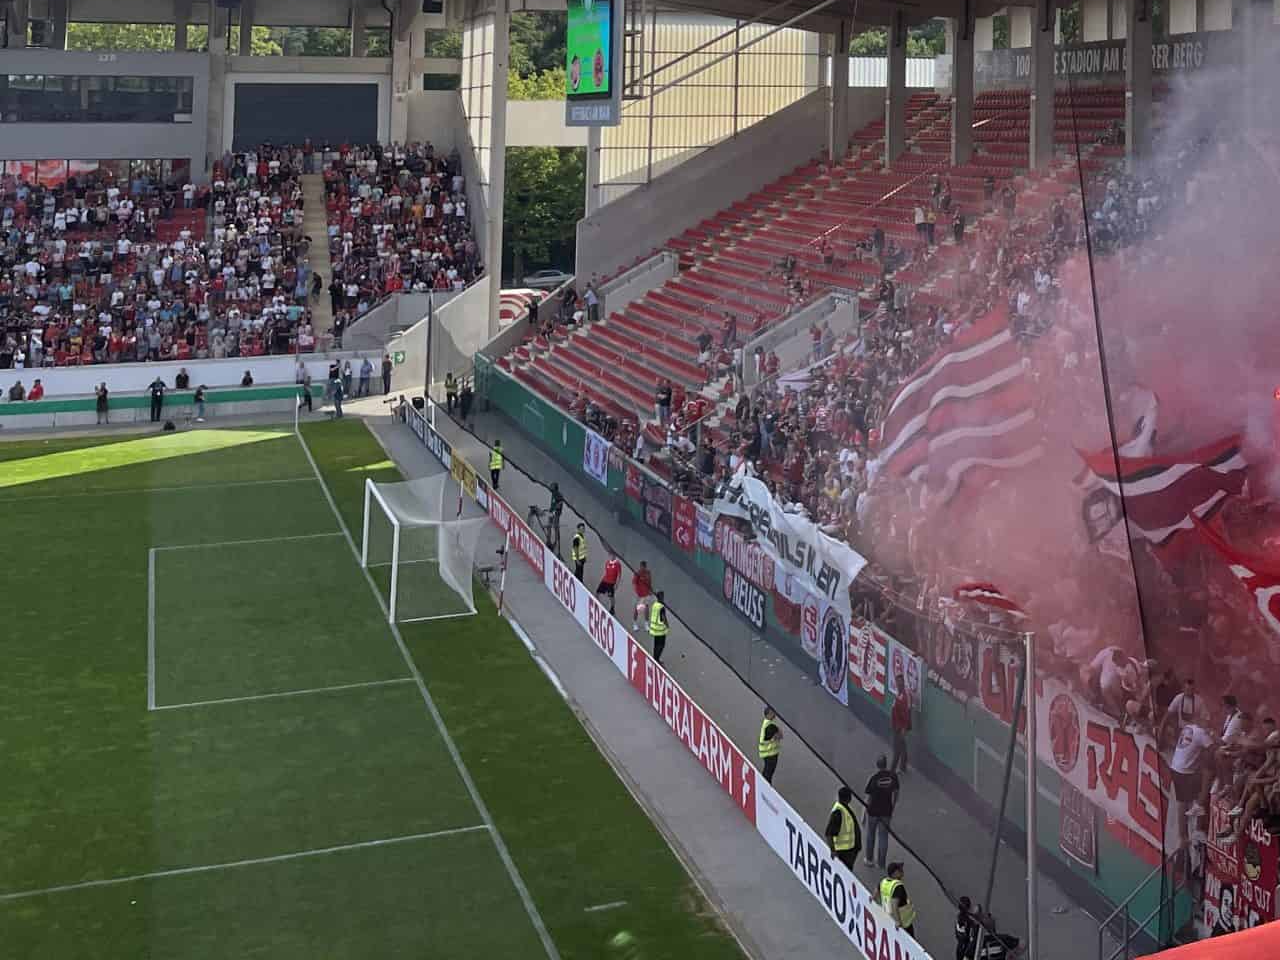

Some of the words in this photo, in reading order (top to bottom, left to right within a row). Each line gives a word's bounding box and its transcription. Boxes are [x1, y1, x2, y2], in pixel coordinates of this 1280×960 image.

[1061, 49, 1101, 74] STADION
[1103, 47, 1119, 73] AM
[1173, 41, 1202, 69] BERG
[552, 559, 576, 614] ERGO
[588, 595, 615, 657] ERGO
[732, 570, 765, 628] NEUSS
[644, 656, 733, 796] FLYERALARM
[785, 818, 847, 925] TARGO
